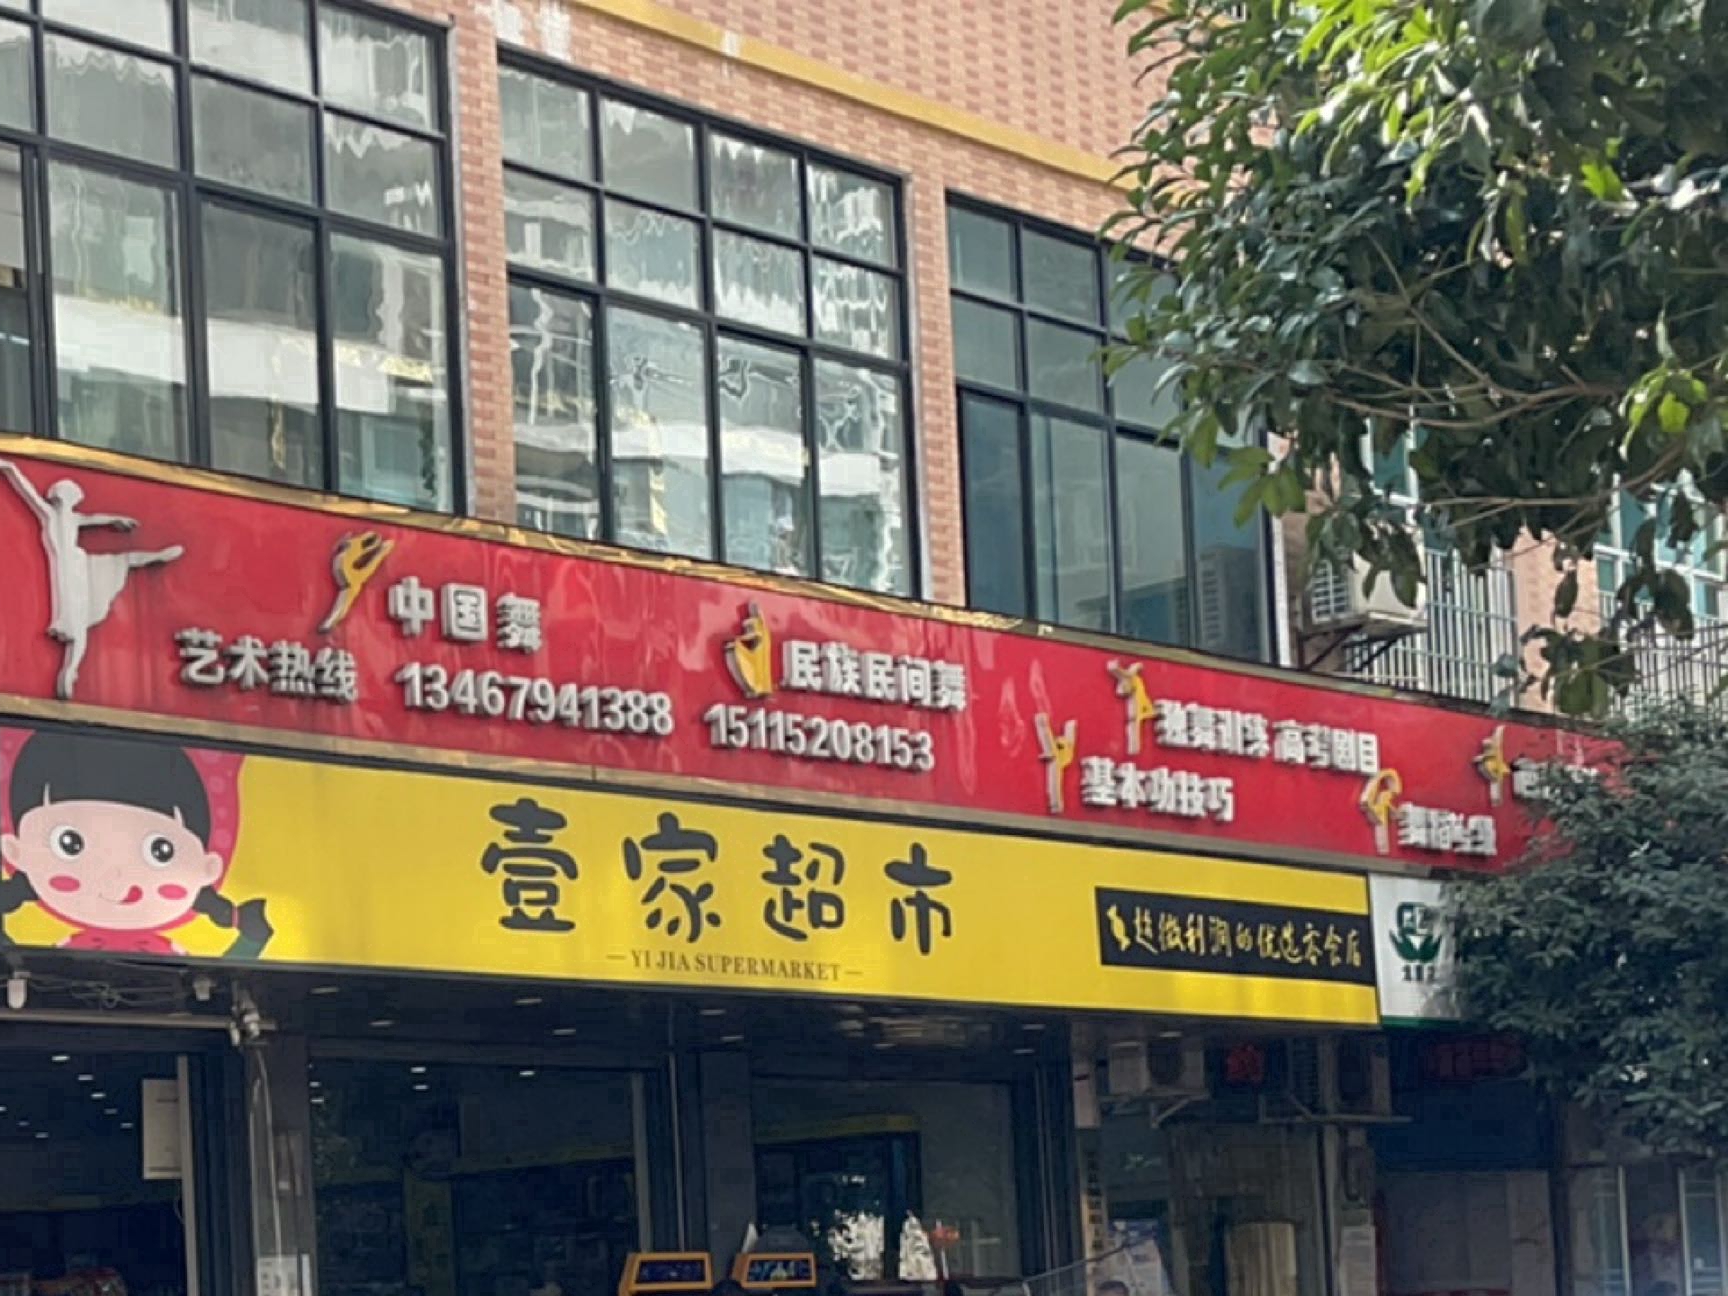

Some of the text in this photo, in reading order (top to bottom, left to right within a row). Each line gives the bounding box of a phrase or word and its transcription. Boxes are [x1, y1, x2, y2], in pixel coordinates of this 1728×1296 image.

[388, 576, 542, 654] 中国舞
[177, 628, 359, 702] 艺术热线
[781, 640, 967, 711] 民族民间舞
[395, 661, 936, 772] 13467941388 15115208153
[1080, 756, 1234, 823] 基本功技巧
[481, 797, 952, 956] 壹家超市
[631, 950, 841, 981] YI JIA SUPERMARKET
